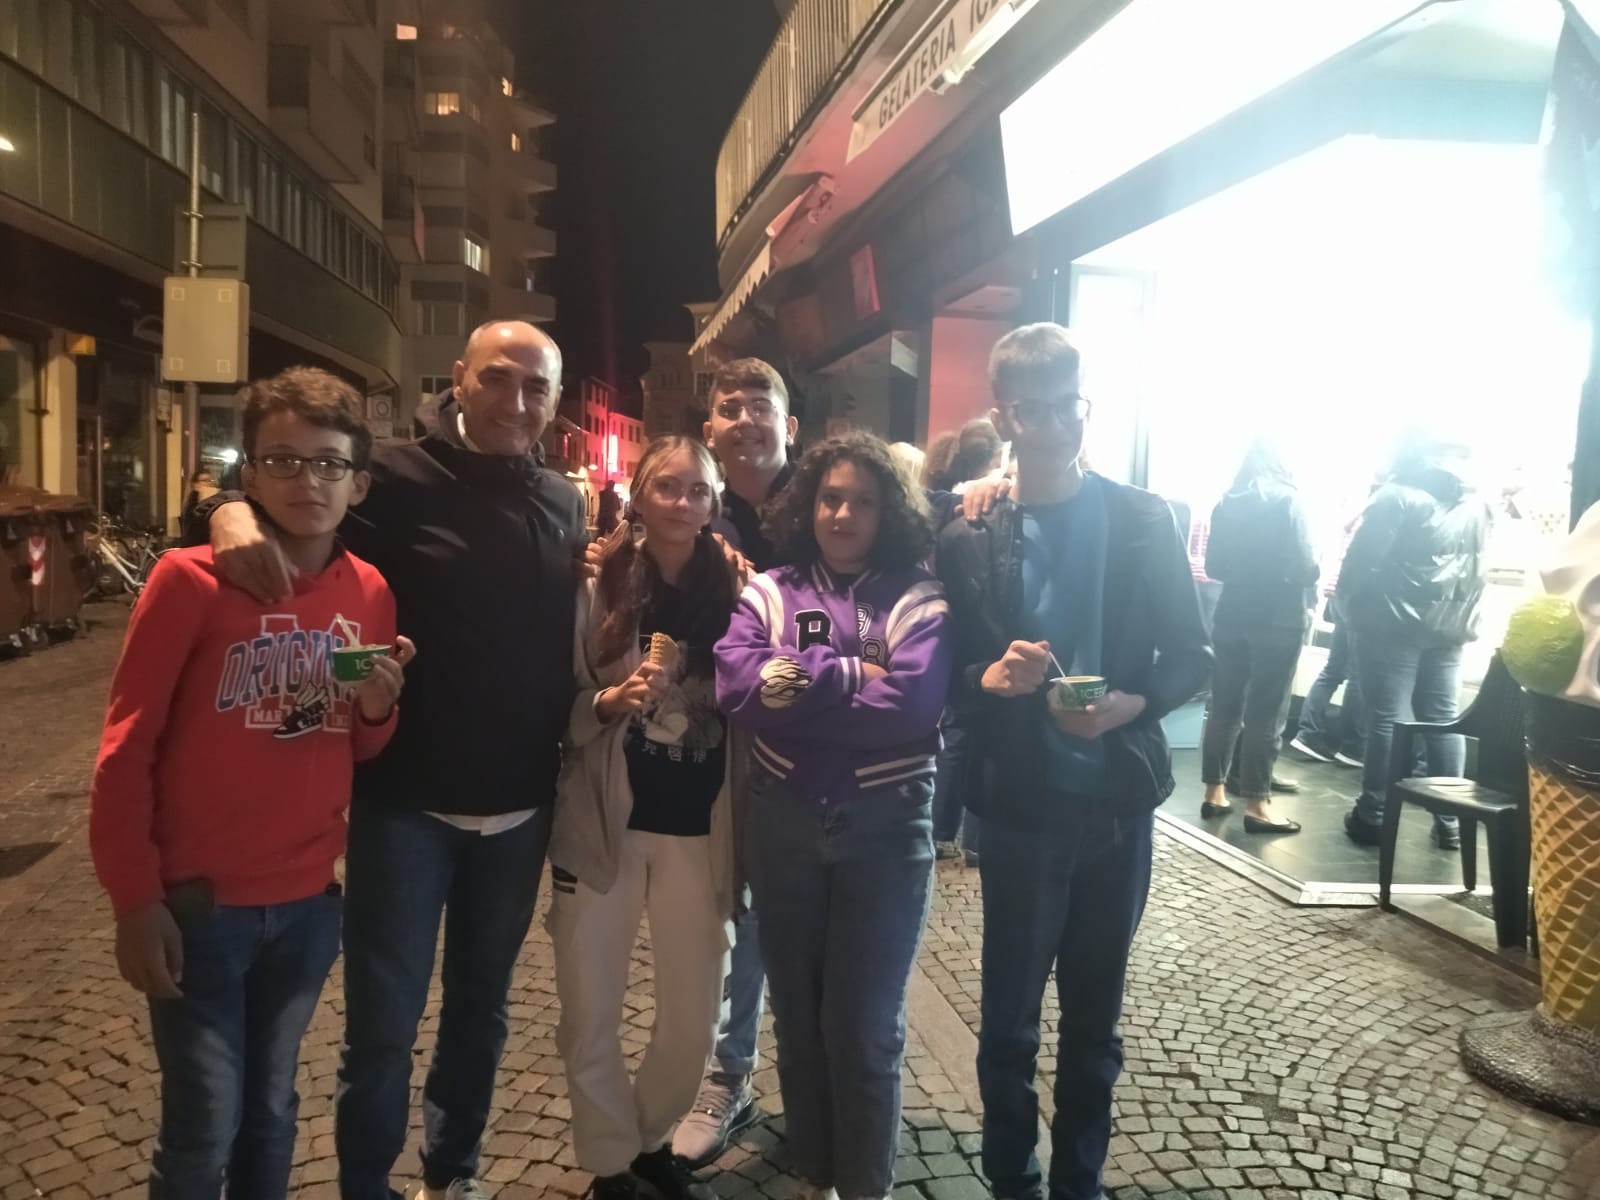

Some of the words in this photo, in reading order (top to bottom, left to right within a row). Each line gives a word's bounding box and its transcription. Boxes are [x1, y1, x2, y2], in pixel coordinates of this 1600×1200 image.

[878, 18, 956, 129] GELATERIA
[969, 0, 998, 33] IC
[216, 630, 345, 712] ORIGIN
